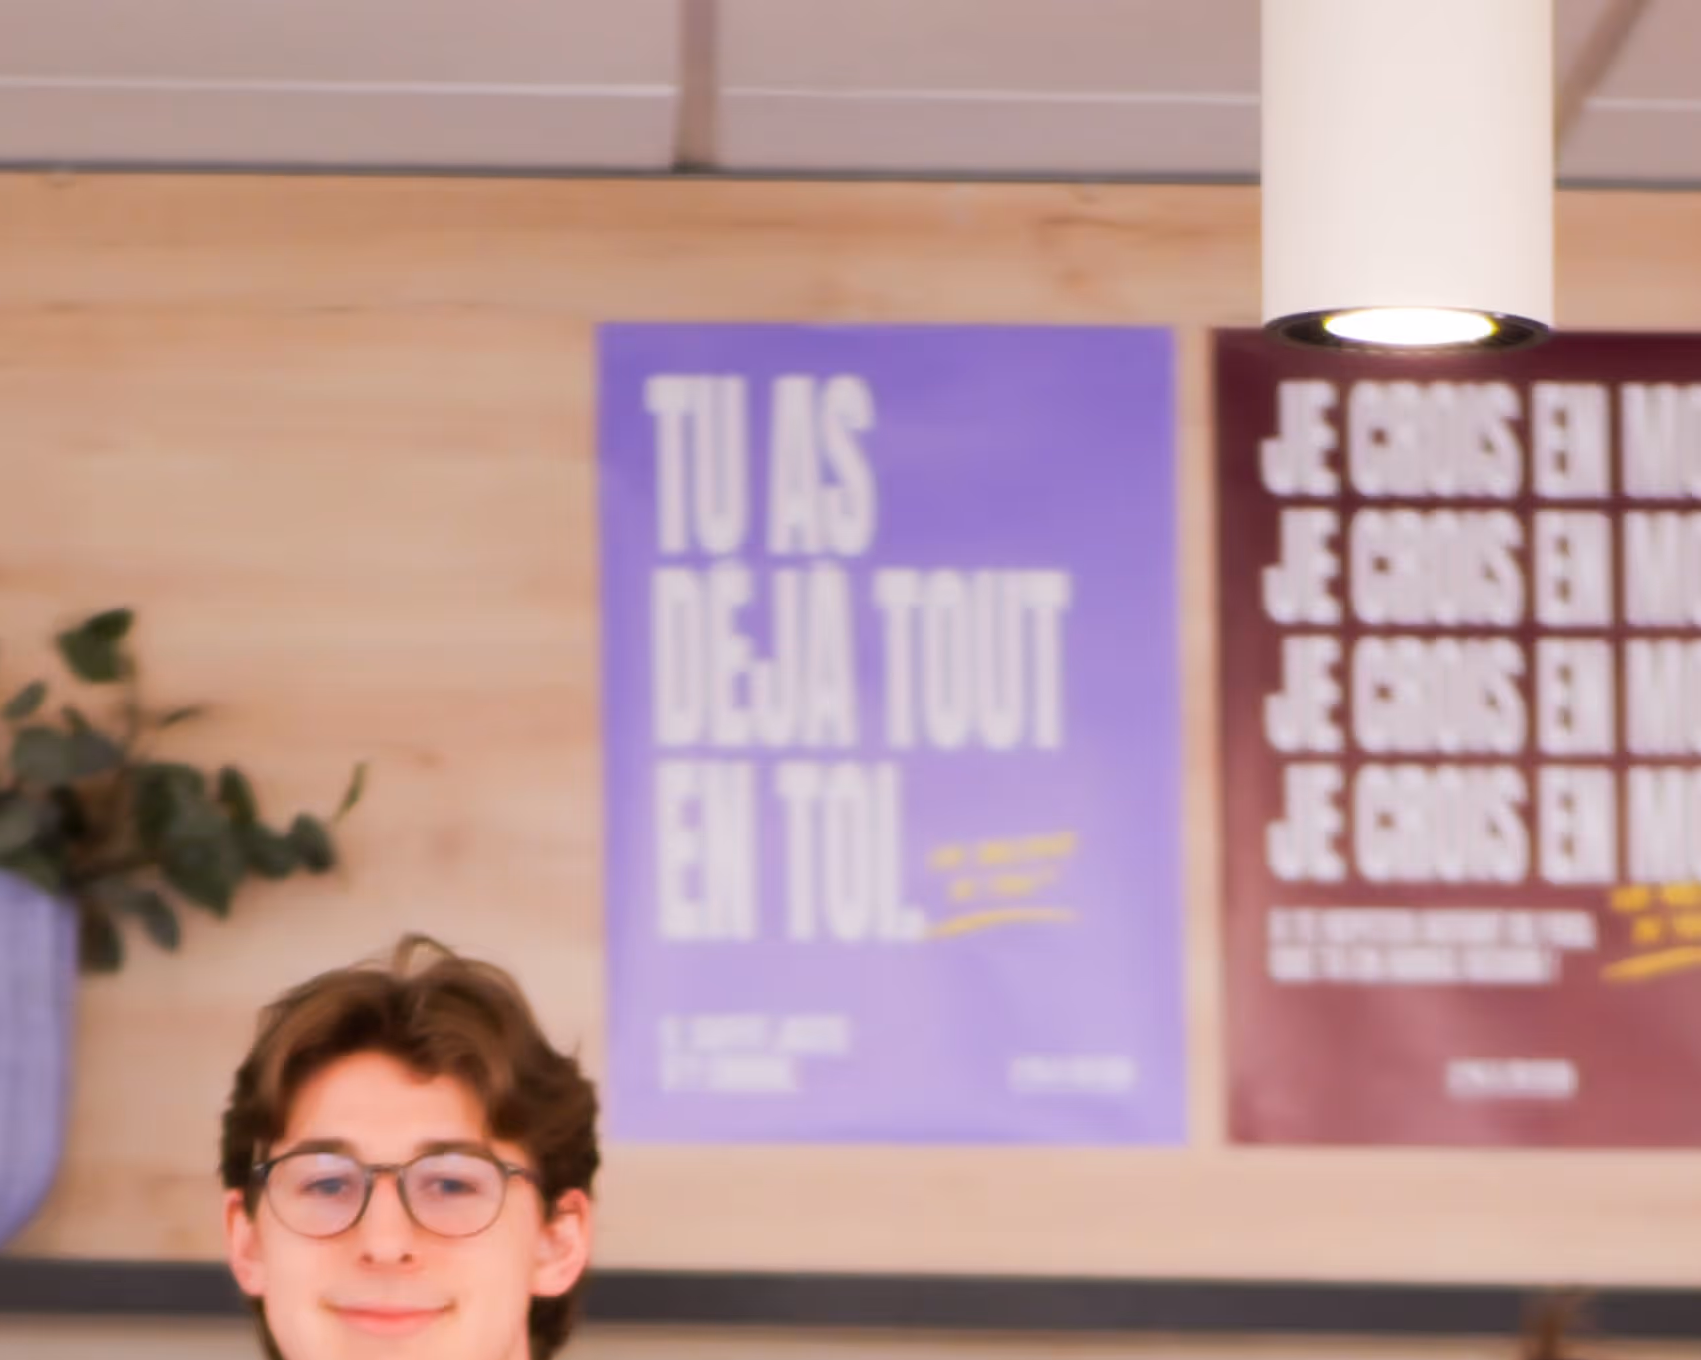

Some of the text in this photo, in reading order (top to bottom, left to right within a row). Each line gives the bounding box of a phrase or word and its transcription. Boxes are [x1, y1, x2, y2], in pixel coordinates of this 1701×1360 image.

[644, 374, 877, 556] TU AS
[1259, 379, 1340, 498] JE
[1347, 380, 1525, 500] CROIS
[1261, 508, 1342, 626] JE
[1350, 509, 1527, 627] CROIS
[873, 567, 1071, 751] TOUT
[1264, 635, 1344, 754] JE
[1352, 636, 1528, 755] CROIS
[655, 760, 758, 941] EN
[1266, 763, 1345, 882] JE
[1354, 764, 1530, 883] CROIS
